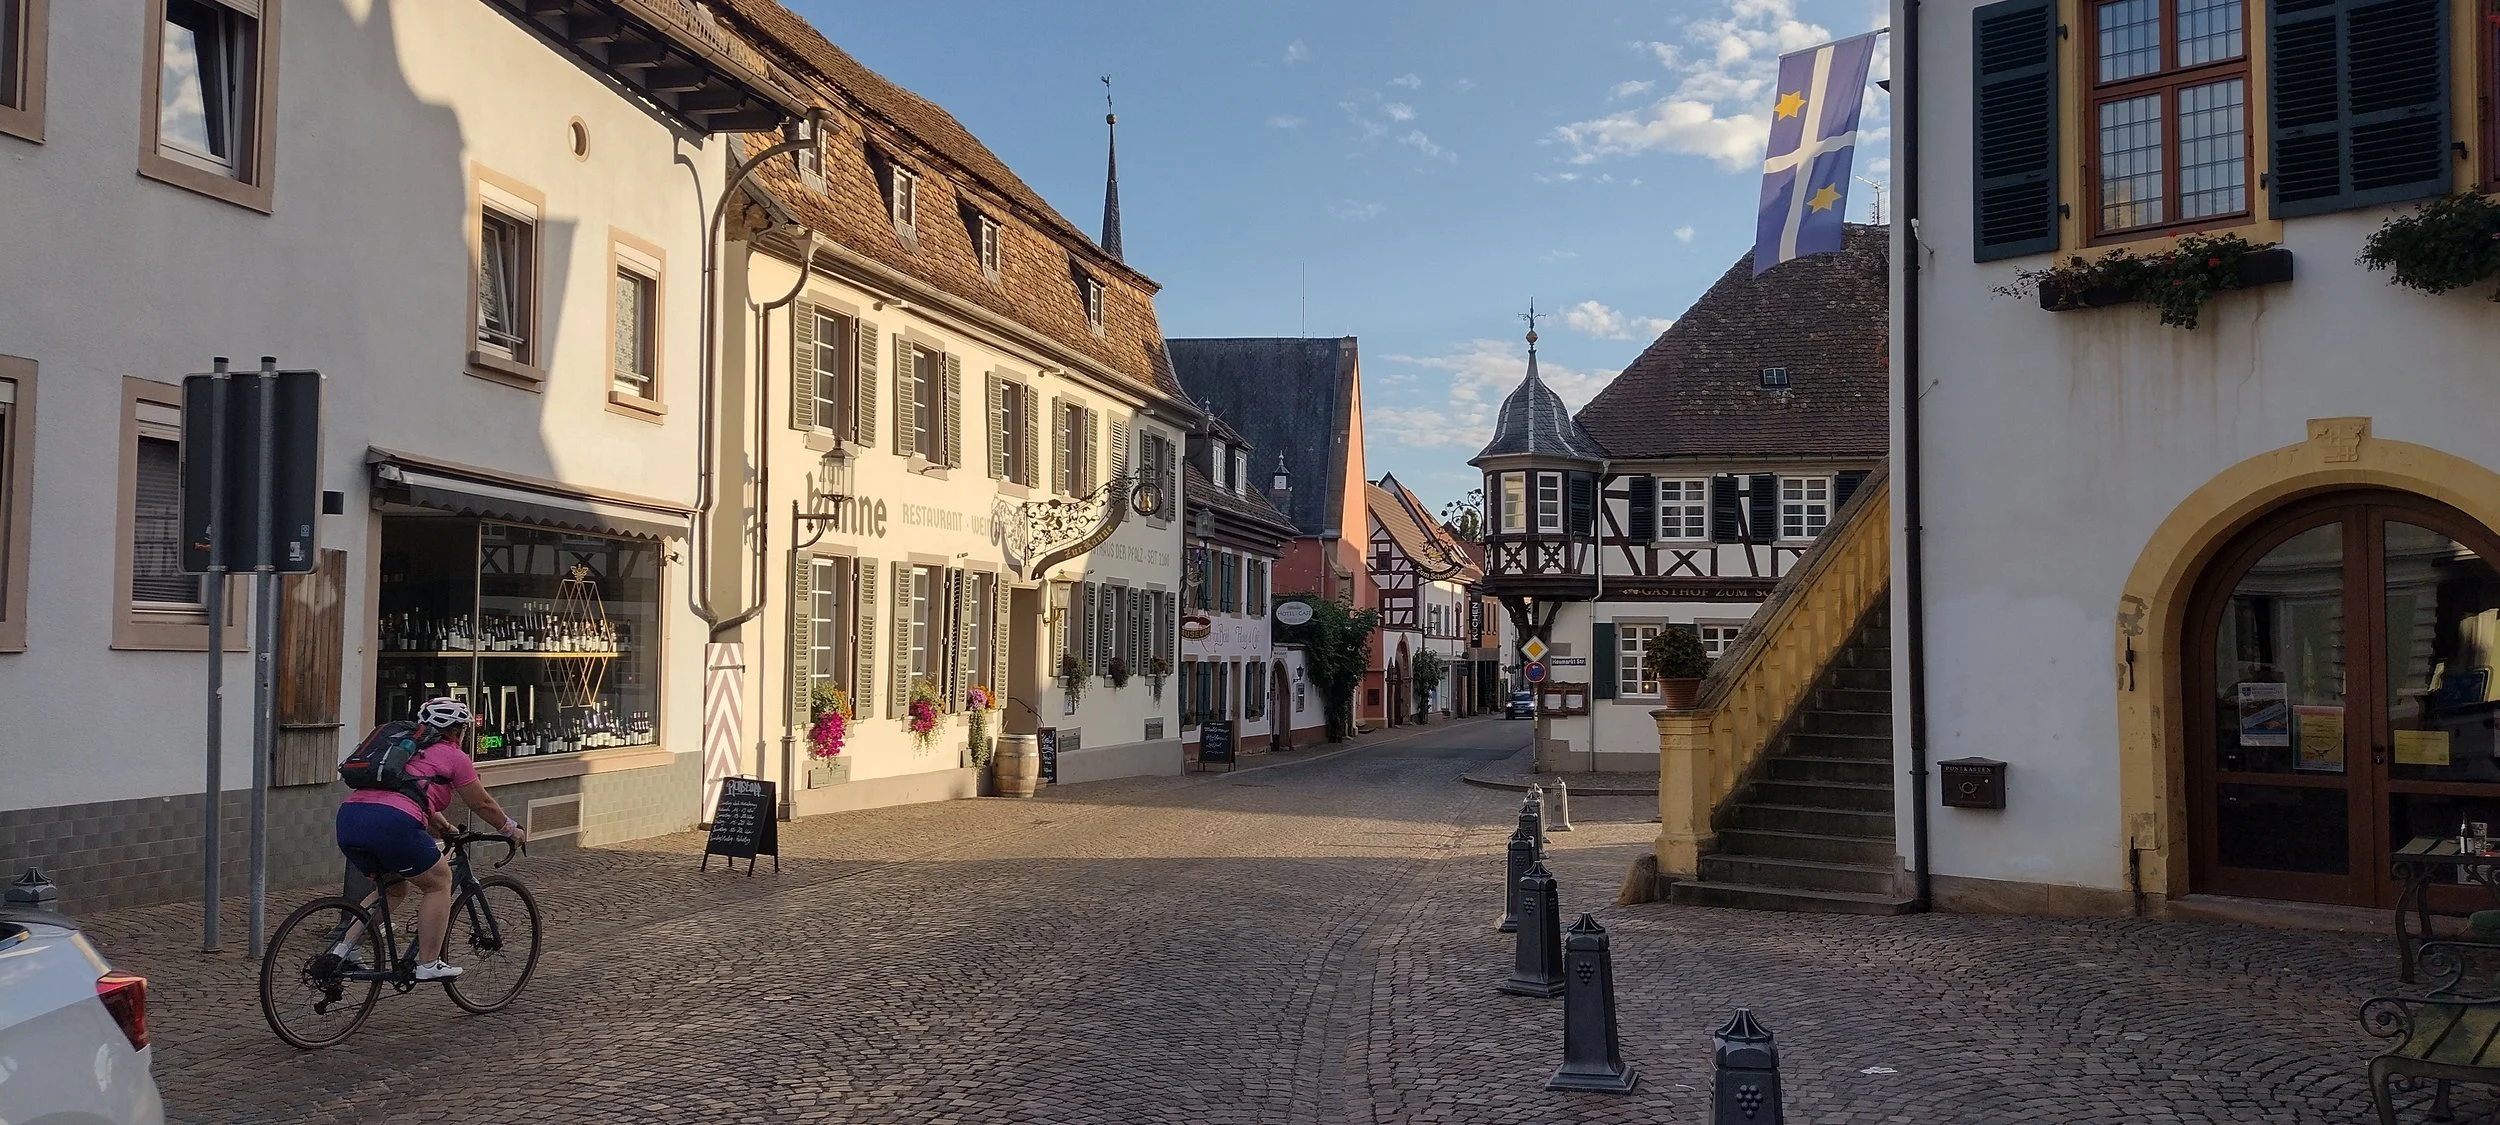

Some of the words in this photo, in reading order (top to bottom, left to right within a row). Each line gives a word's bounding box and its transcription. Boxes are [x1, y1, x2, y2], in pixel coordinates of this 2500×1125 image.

[902, 503, 963, 532] RESTAURANT
[1083, 525, 1114, 551] Kanne
[1115, 543, 1127, 560] DER
[1127, 546, 1143, 563] PFALZ
[1415, 565, 1430, 579] Zum
[1430, 566, 1460, 581] Schwanen
[1641, 587, 1709, 597] GASTHOF
[1715, 587, 1748, 598] ZUM
[1181, 627, 1211, 639] MUSEUM
[480, 735, 502, 748] OPEN
